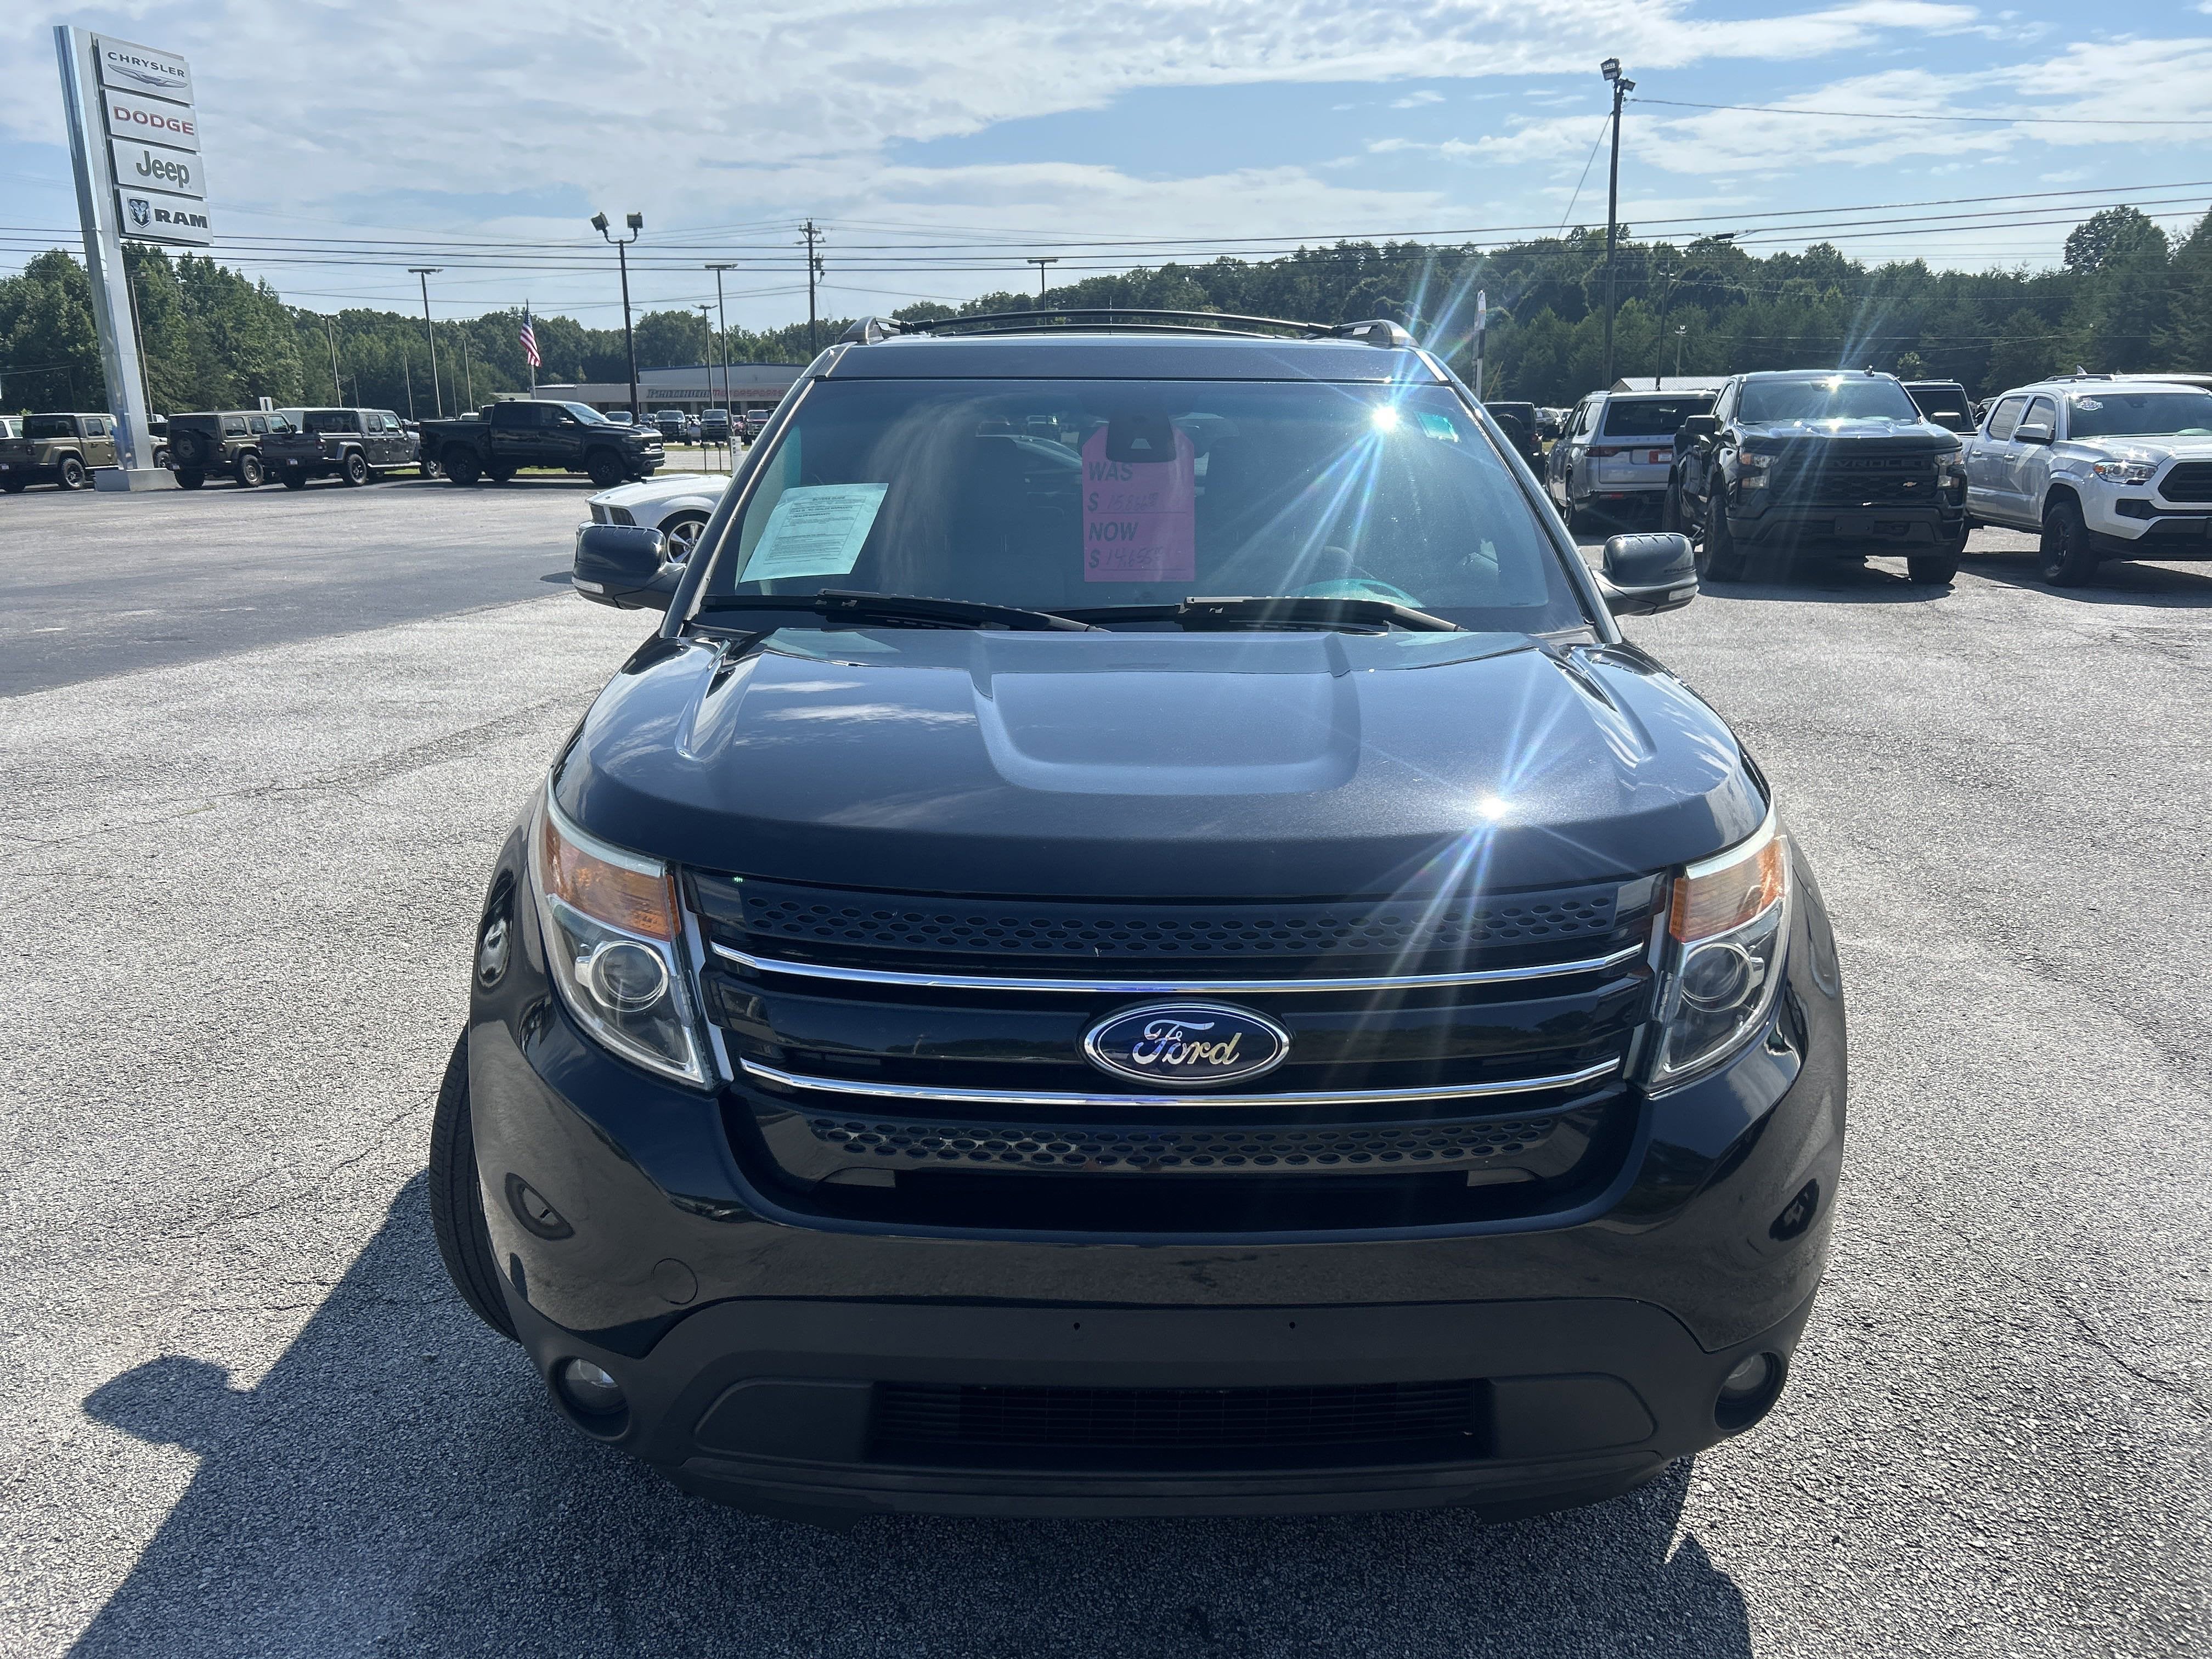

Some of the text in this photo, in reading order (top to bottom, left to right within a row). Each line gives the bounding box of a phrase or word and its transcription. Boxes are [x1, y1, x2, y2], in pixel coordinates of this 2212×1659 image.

[108, 51, 185, 78] CHRYSLER
[114, 106, 195, 136] DODGE
[136, 150, 190, 188] Jeep
[155, 208, 208, 229] RAM
[1088, 461, 1133, 481] WAS
[1787, 457, 1931, 470] EVROLET
[1087, 492, 1099, 512] $
[1088, 522, 1139, 541] NOW
[1088, 549, 1101, 568] $
[1132, 1019, 1242, 1065] Ford
